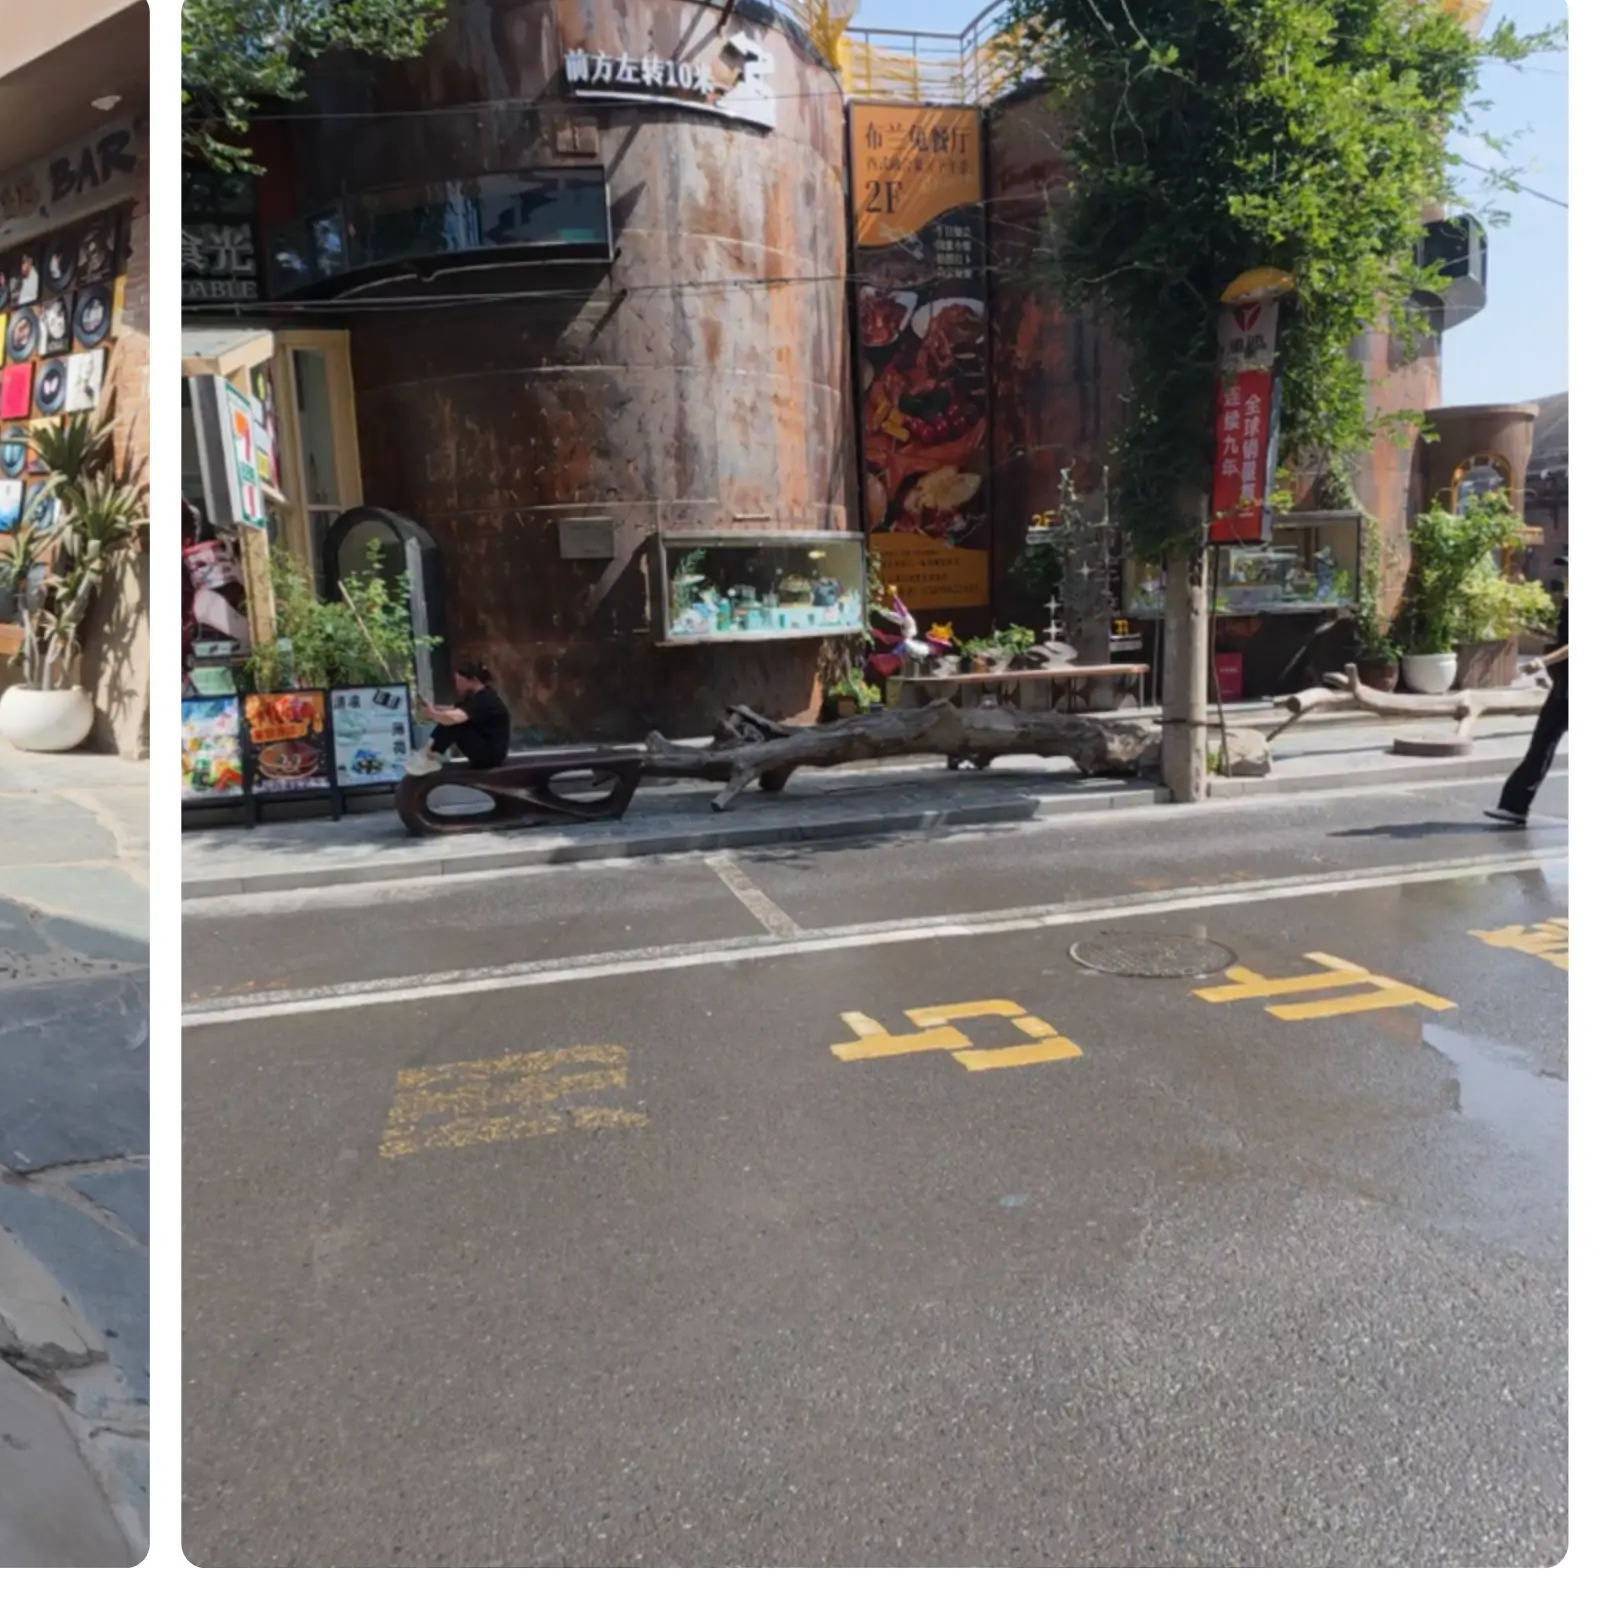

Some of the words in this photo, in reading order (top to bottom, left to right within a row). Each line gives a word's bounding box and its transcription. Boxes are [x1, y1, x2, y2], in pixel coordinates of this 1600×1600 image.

[564, 48, 713, 94] 前方左转10米
[49, 130, 138, 200] BAR
[865, 180, 903, 214] 2F
